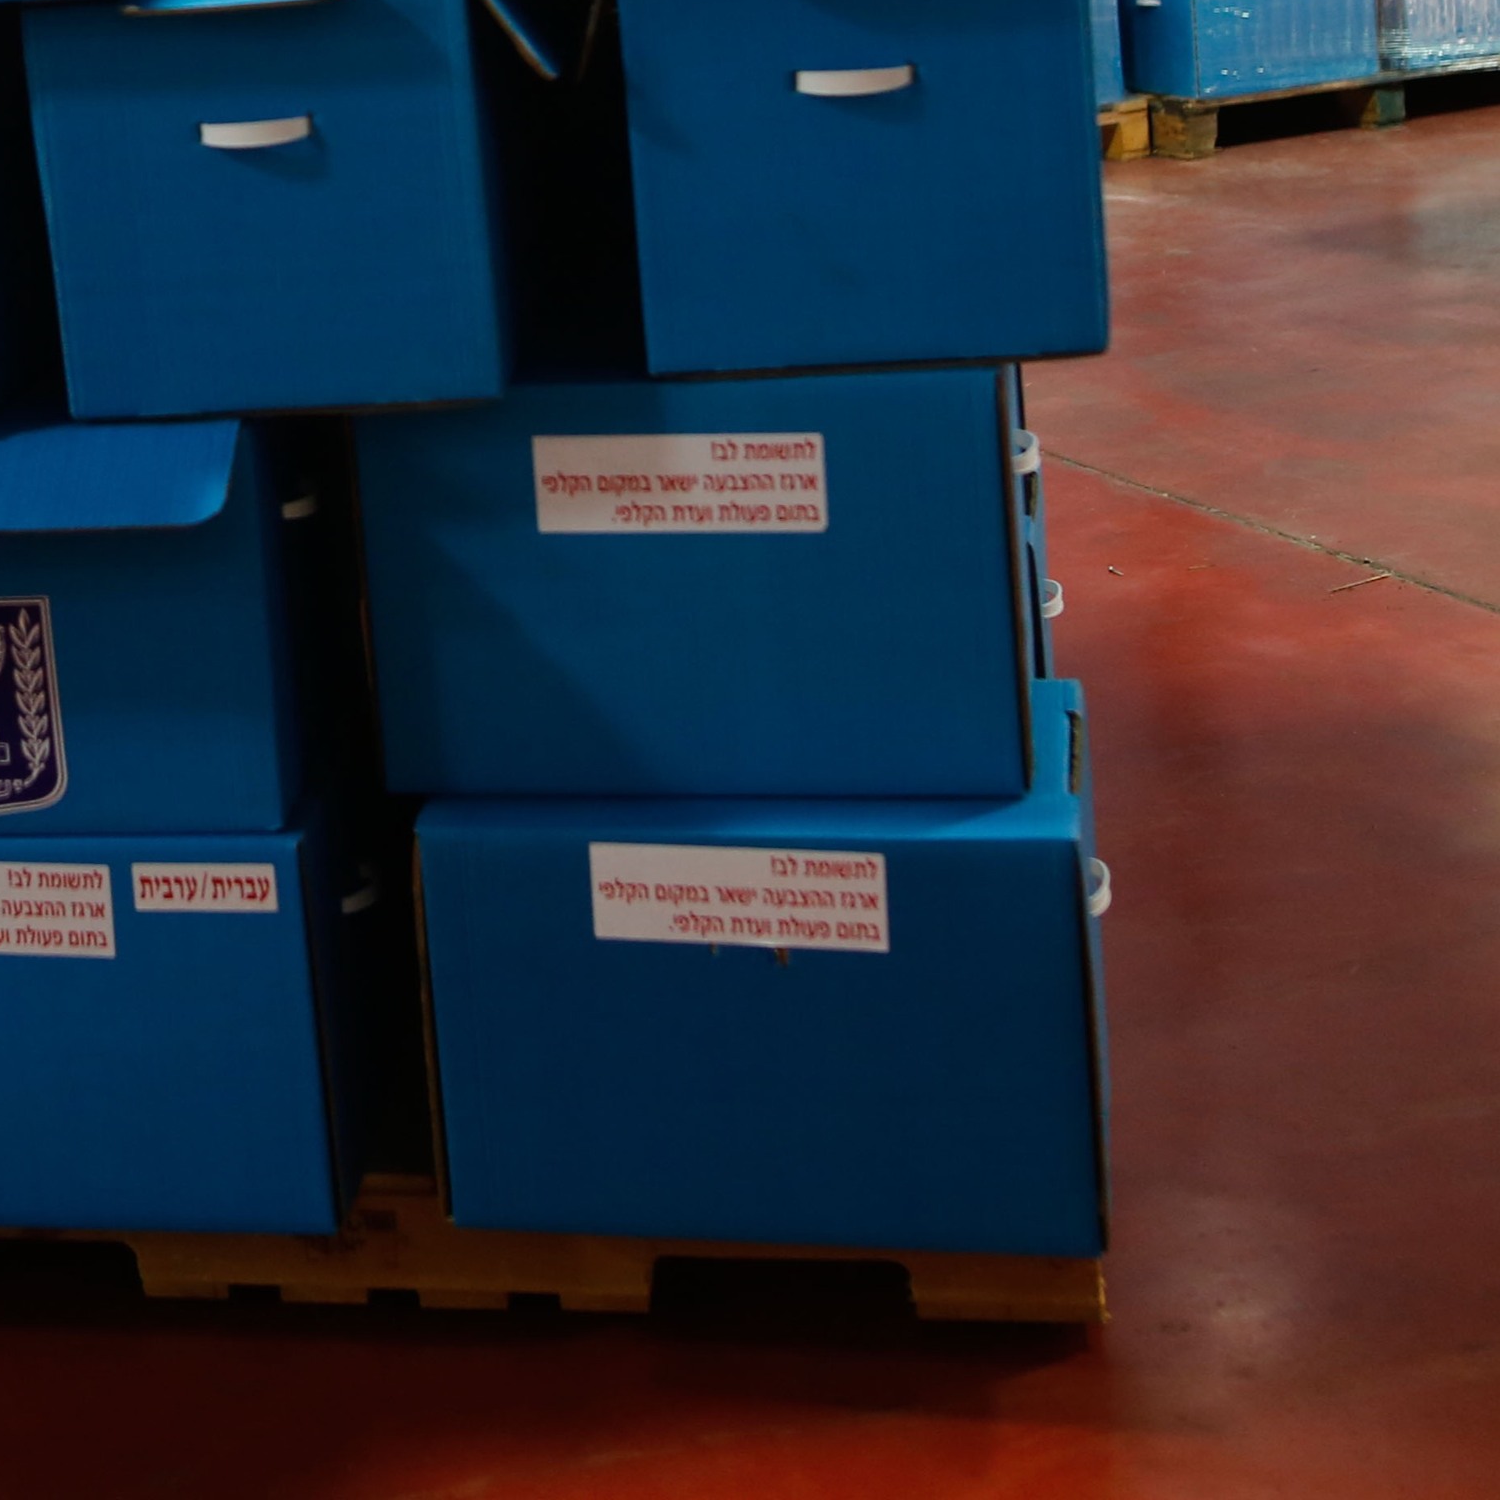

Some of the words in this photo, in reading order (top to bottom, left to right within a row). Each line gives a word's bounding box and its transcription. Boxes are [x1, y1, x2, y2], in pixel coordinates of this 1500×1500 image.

[743, 438, 817, 461] לתשומת
[541, 471, 592, 496] הקלפי
[597, 474, 651, 496] במקום
[657, 474, 698, 491] ישאר
[703, 474, 776, 491] ההצבעה
[780, 474, 818, 491] ארגז
[673, 504, 713, 522] ועדת
[718, 500, 771, 522] פעולת
[778, 504, 820, 522] בתום
[804, 857, 878, 880] לתשומת
[38, 869, 103, 890] לתשומת
[139, 871, 270, 902] עברית/ערבית
[599, 878, 648, 904] הקלפי
[655, 883, 709, 906] במקום
[716, 886, 757, 905] ישאר
[762, 888, 836, 908] ההצבעה
[840, 891, 879, 910] ארגז
[2, 899, 66, 917] ההצבעה
[71, 901, 105, 918] ארגז
[16, 925, 63, 945] פעולת
[731, 916, 772, 936] ועדת
[778, 915, 830, 939] פעולת
[838, 922, 880, 940] בתום
[69, 930, 108, 947] בתום
